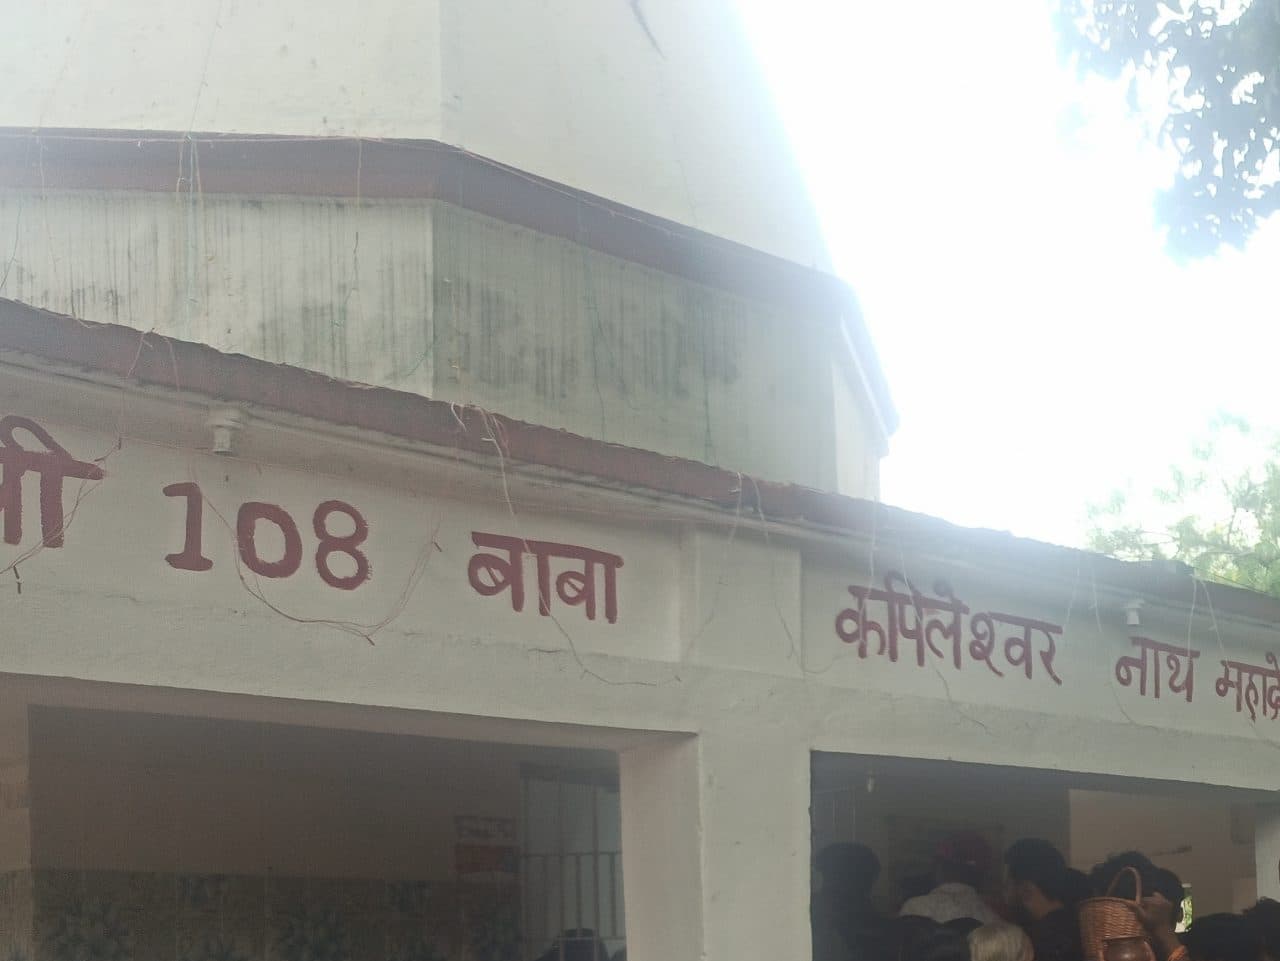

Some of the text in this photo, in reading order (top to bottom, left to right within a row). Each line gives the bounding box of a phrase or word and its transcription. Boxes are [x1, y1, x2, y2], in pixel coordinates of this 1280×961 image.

[163, 483, 371, 590] 108
[467, 531, 623, 624] बाबा
[835, 571, 1063, 685] कपिलेश्वर
[1115, 637, 1200, 702] नाथ
